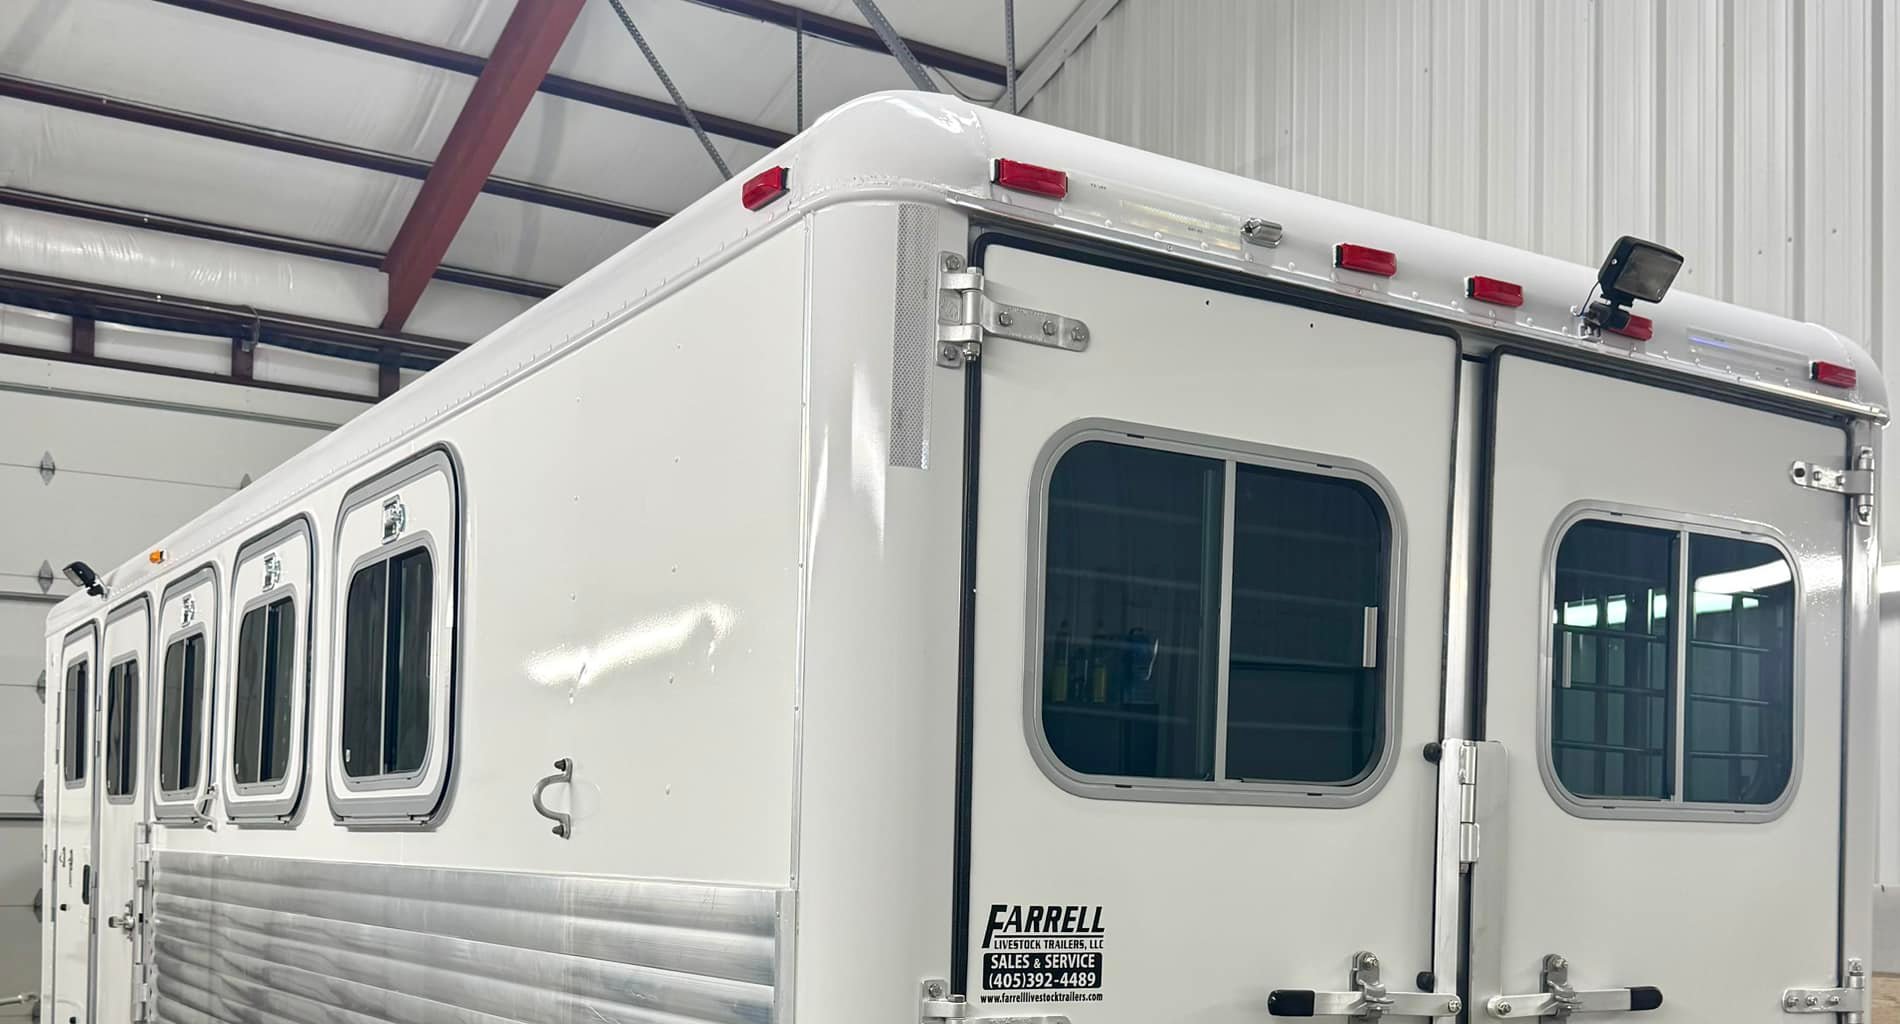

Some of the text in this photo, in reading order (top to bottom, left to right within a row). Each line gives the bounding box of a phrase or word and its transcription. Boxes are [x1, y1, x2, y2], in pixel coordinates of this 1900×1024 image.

[982, 905, 1105, 948] FARRELL
[994, 940, 1104, 950] LIVESTOCK TRAILERS, LLC
[991, 954, 1096, 969] SALES & SERVICE
[989, 972, 1096, 988] (405)392-4489
[980, 992, 1103, 1003] www.farrelllivestocktrailers.com
